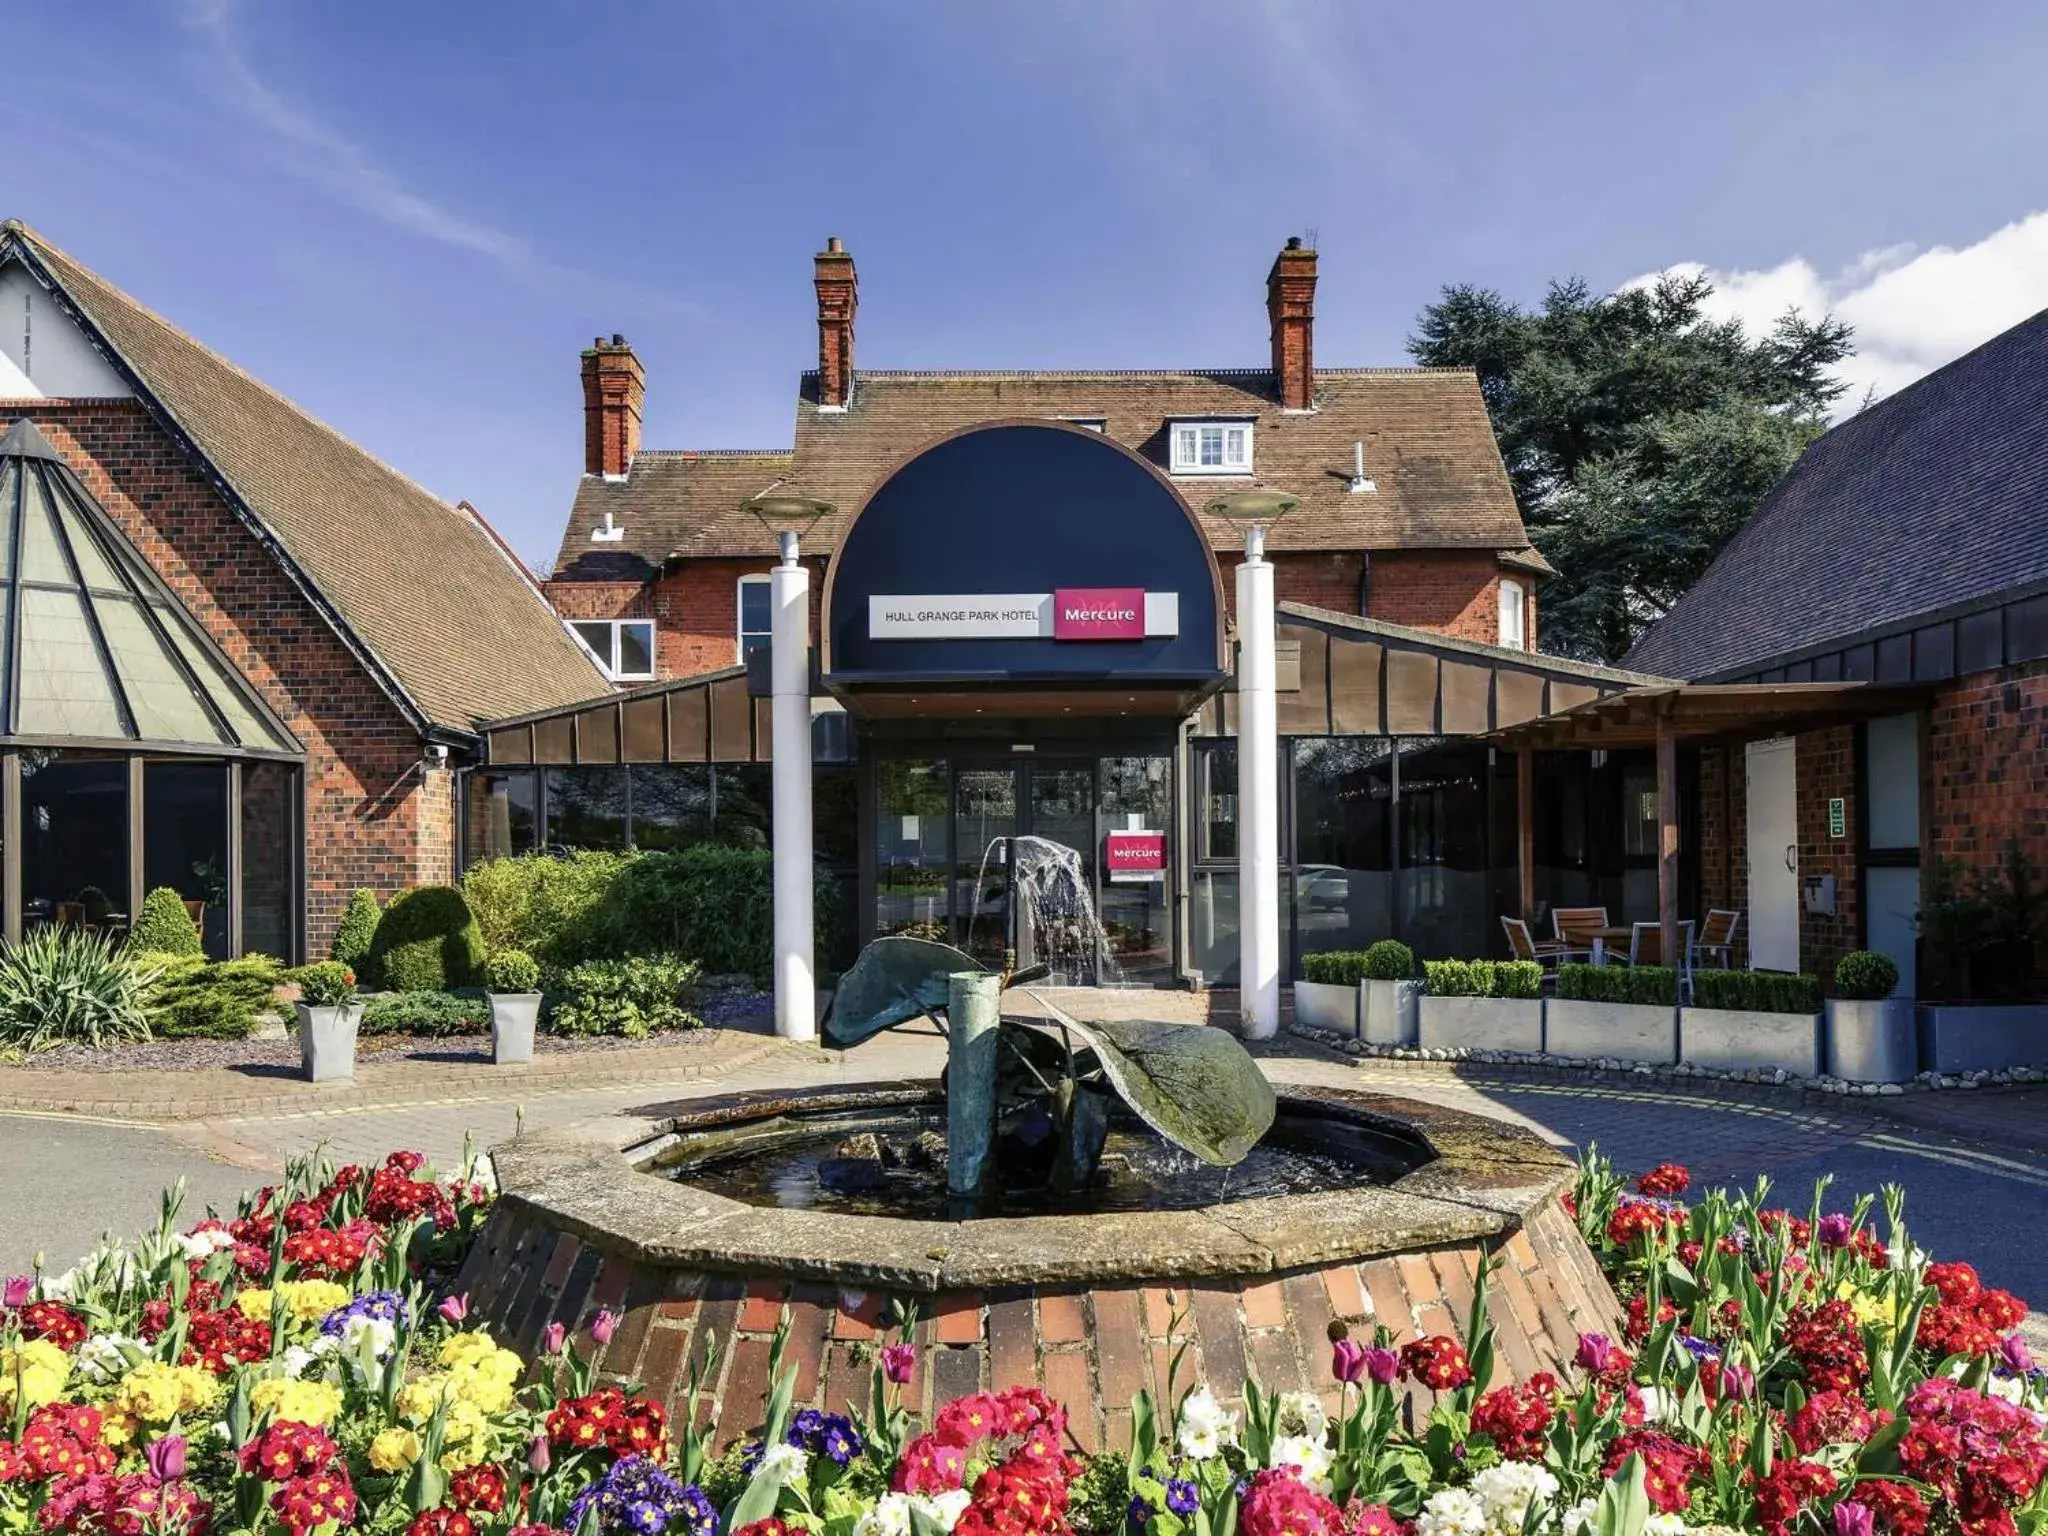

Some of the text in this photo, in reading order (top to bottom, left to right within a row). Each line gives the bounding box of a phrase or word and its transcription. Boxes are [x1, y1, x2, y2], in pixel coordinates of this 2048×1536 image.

[885, 610, 1039, 622] HULL GRANGE PARK HOTEL
[1065, 607, 1136, 621] Mercure
[1113, 848, 1161, 858] Mercure
